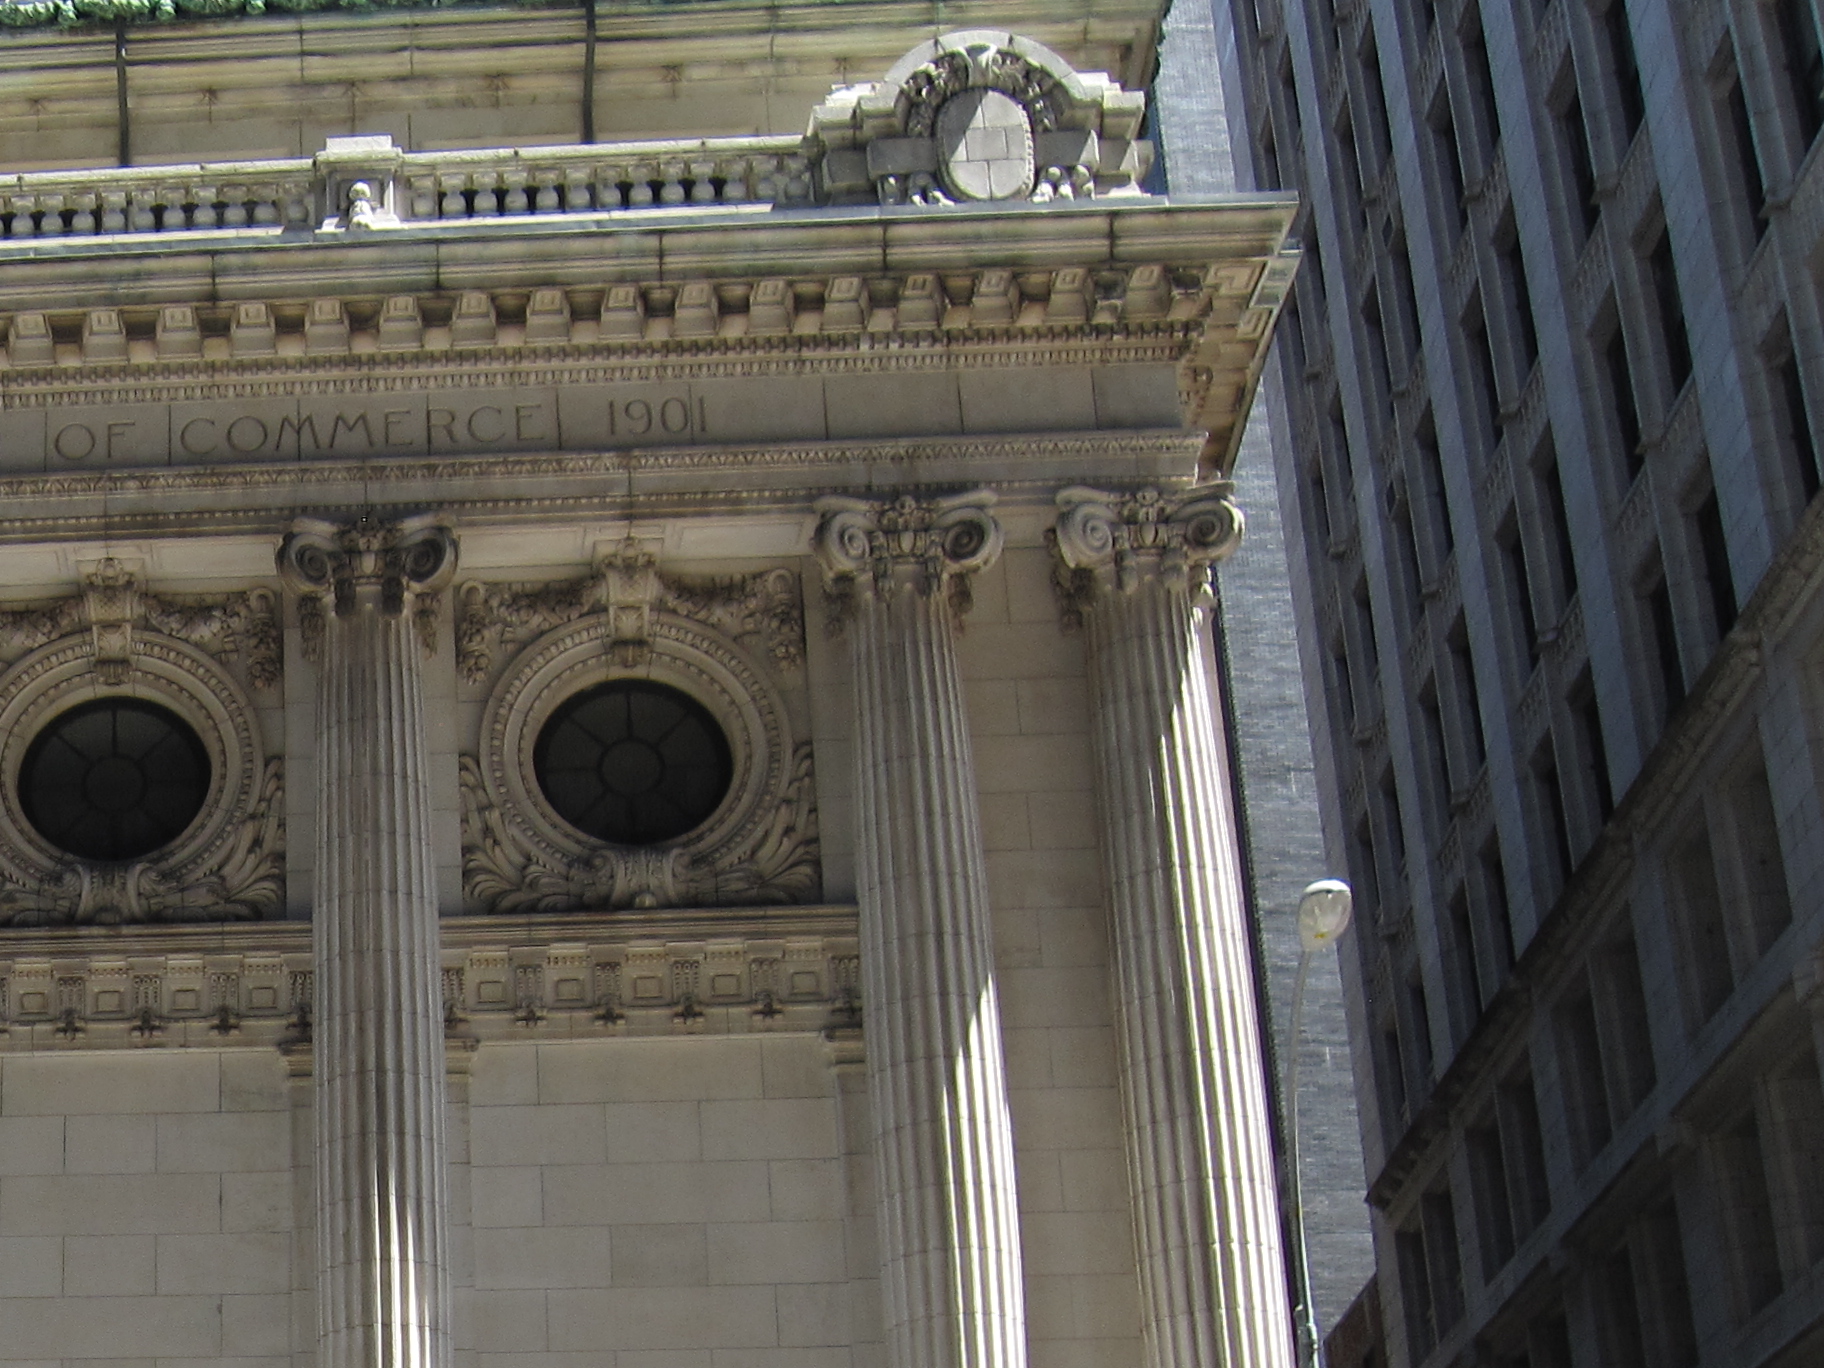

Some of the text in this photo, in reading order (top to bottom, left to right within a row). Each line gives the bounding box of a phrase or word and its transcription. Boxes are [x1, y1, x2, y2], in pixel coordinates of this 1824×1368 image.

[54, 420, 137, 461] OF
[179, 402, 547, 454] COMMERCE
[606, 394, 708, 437] 1901
